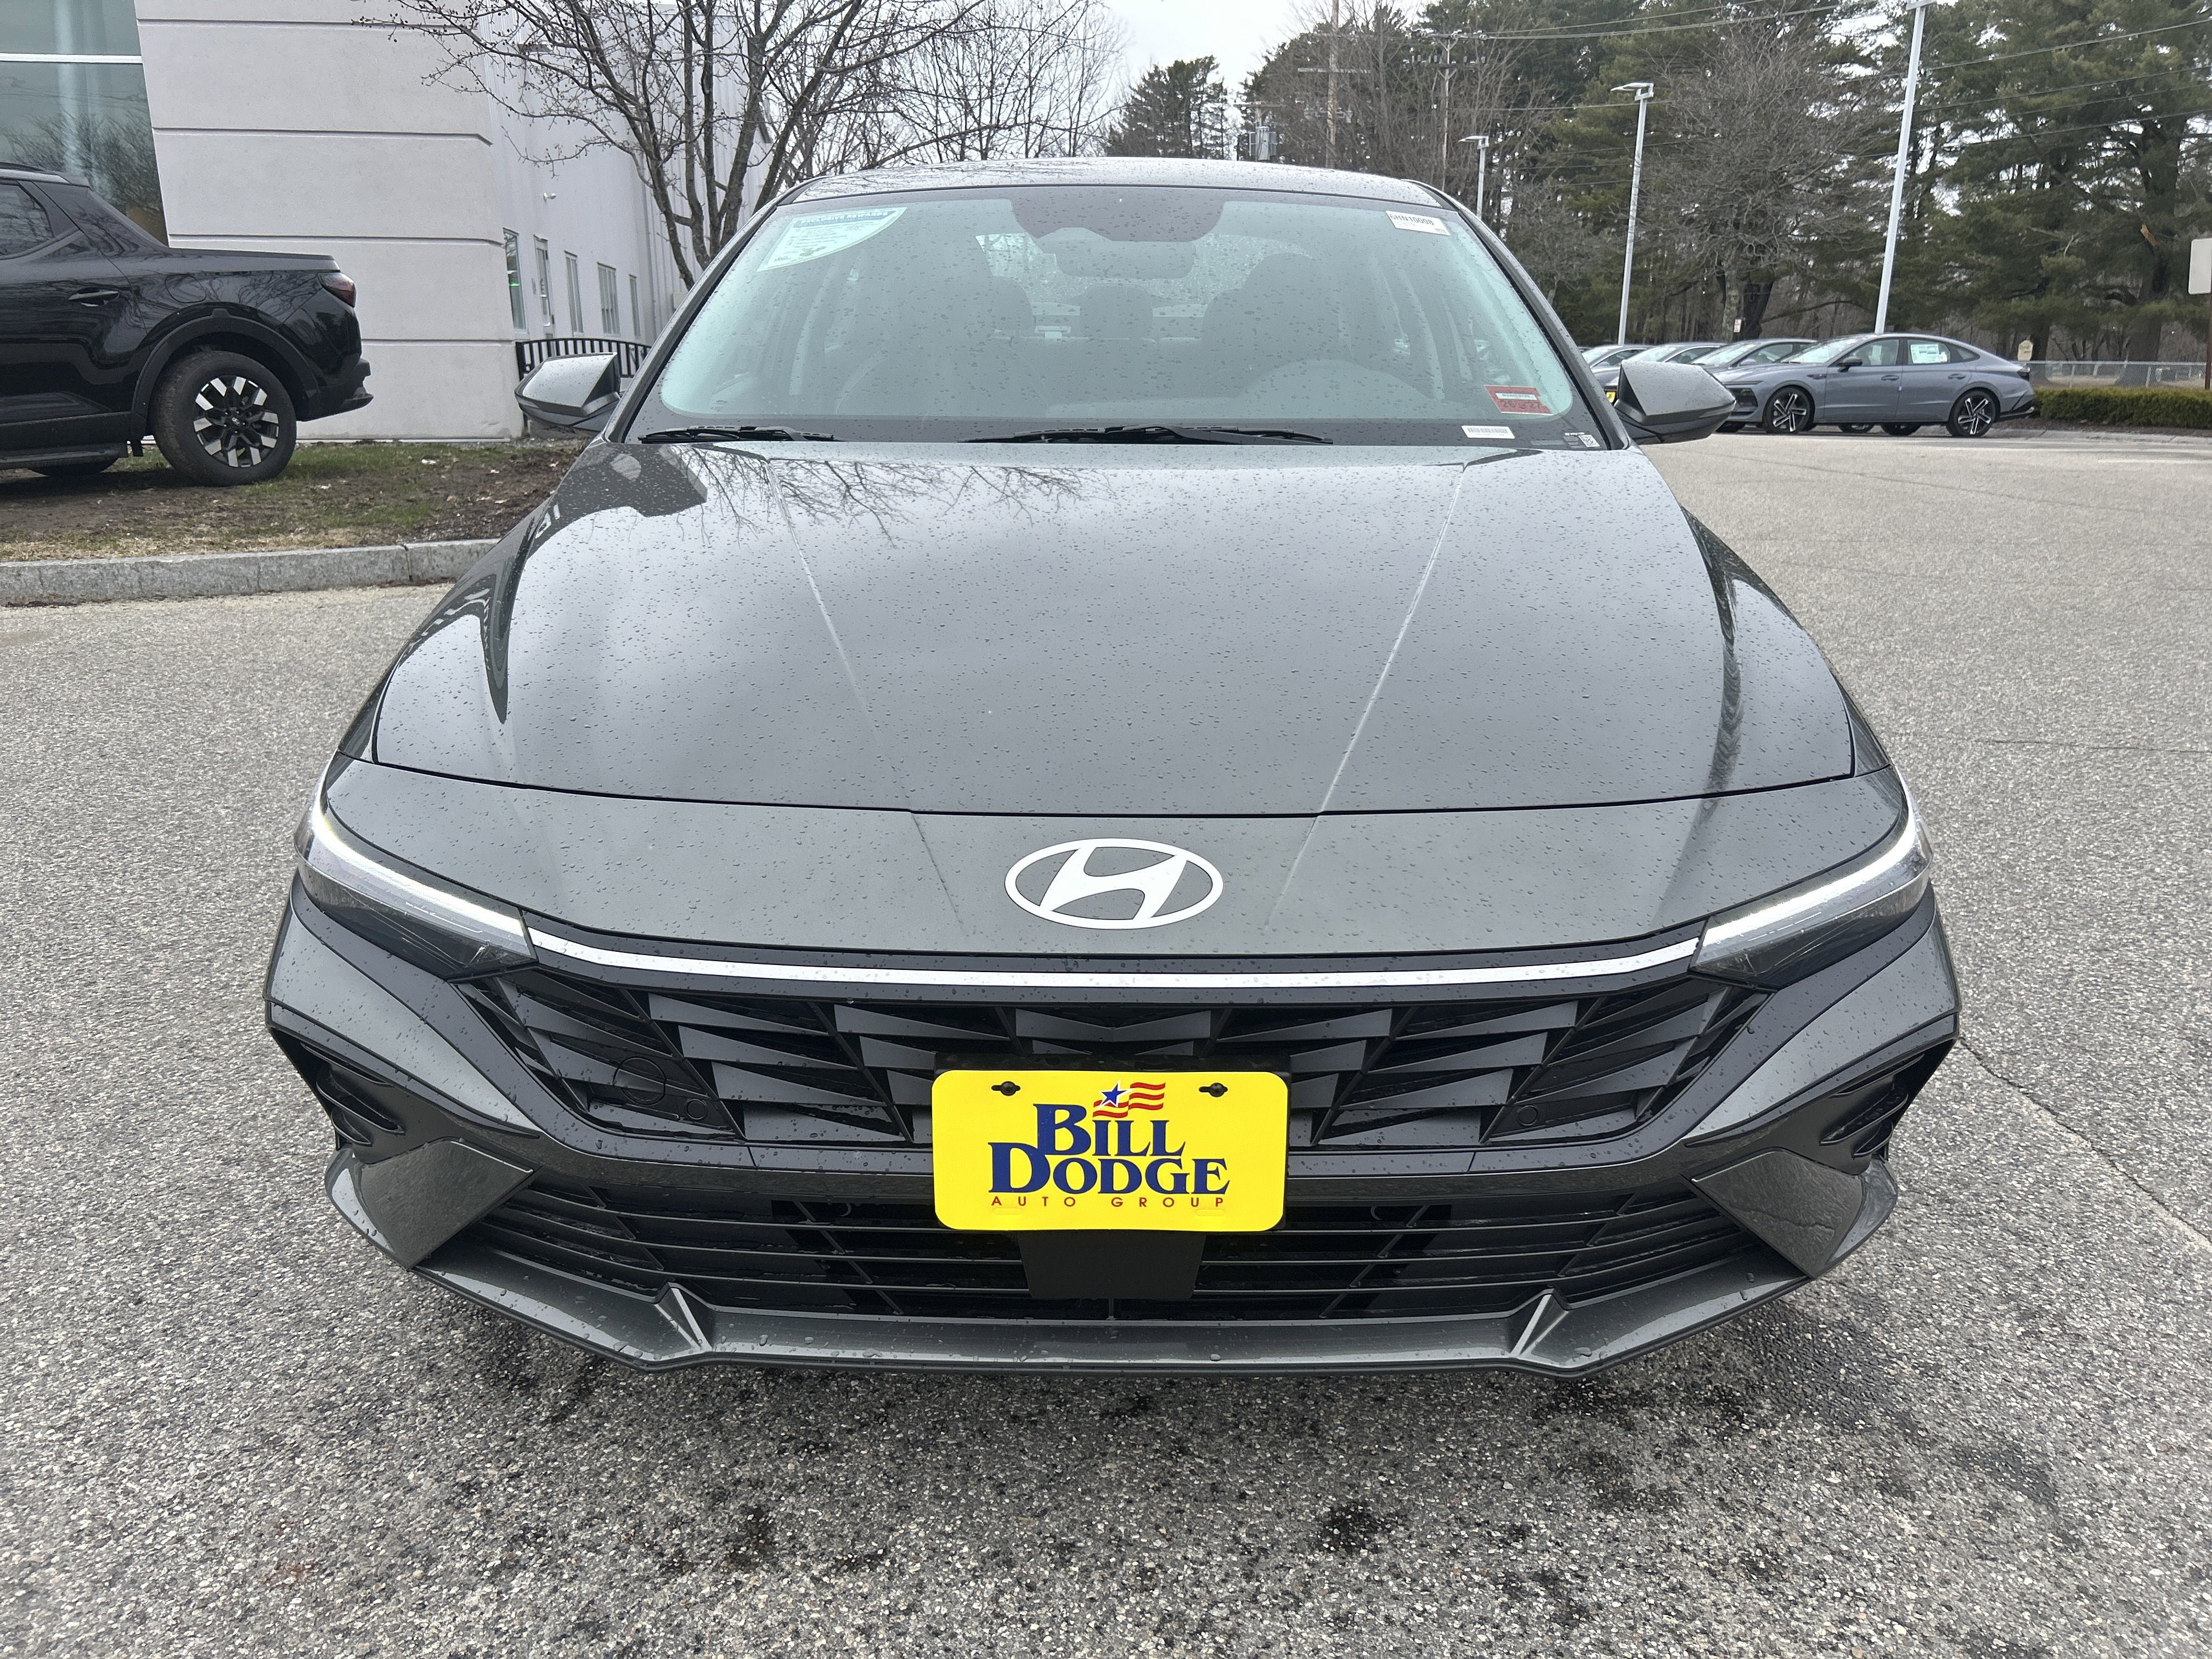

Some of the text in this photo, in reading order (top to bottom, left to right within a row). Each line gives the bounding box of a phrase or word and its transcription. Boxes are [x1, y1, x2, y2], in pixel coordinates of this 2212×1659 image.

[1032, 1103, 1186, 1156] BILL
[988, 1141, 1231, 1195] DODGE
[991, 1195, 1224, 1208] AUTO GROUP
